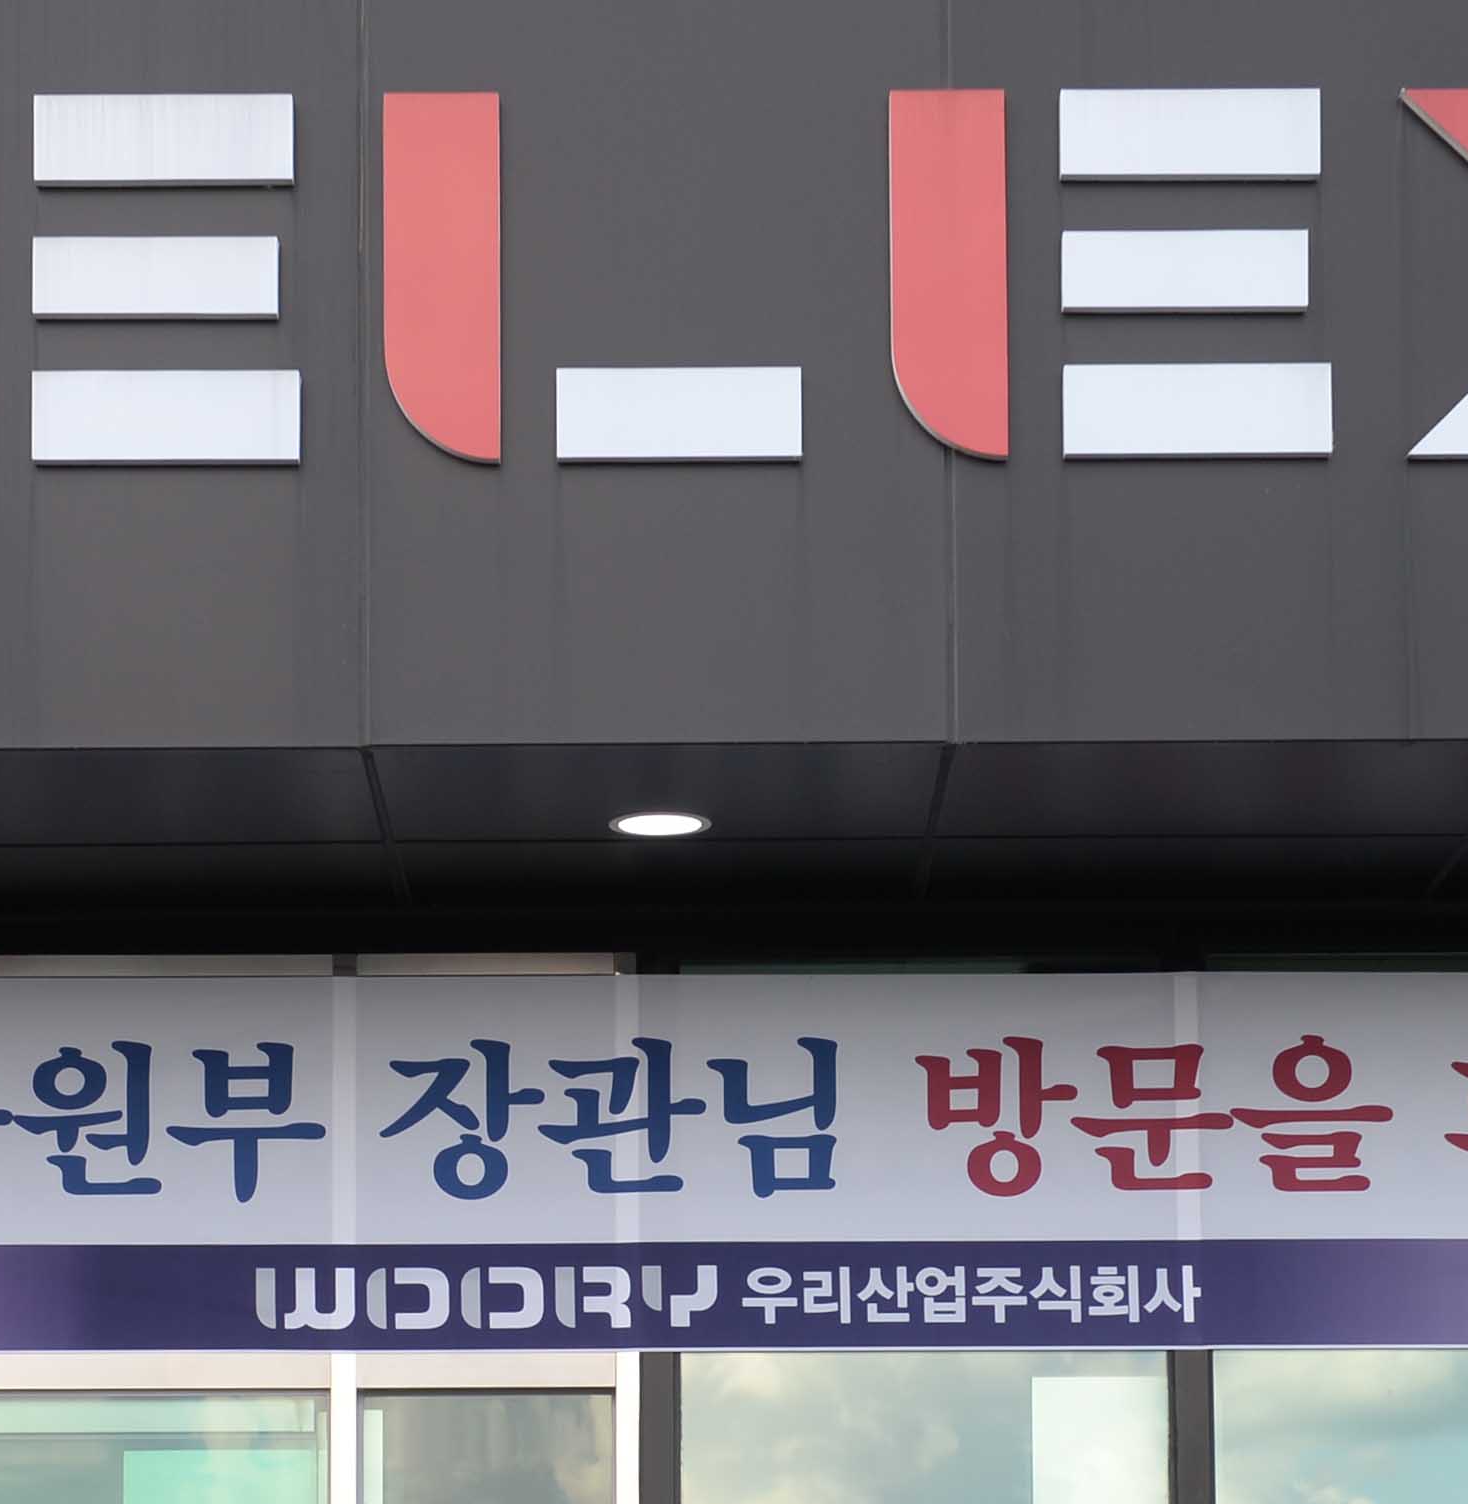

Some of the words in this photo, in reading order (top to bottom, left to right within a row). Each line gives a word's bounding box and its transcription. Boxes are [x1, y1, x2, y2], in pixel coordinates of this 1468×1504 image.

[380, 1037, 839, 1200] 장관님
[916, 1036, 1394, 1197] 방문을
[255, 1265, 718, 1331] WOORY
[741, 1265, 1202, 1325] 우리산업주식회사
